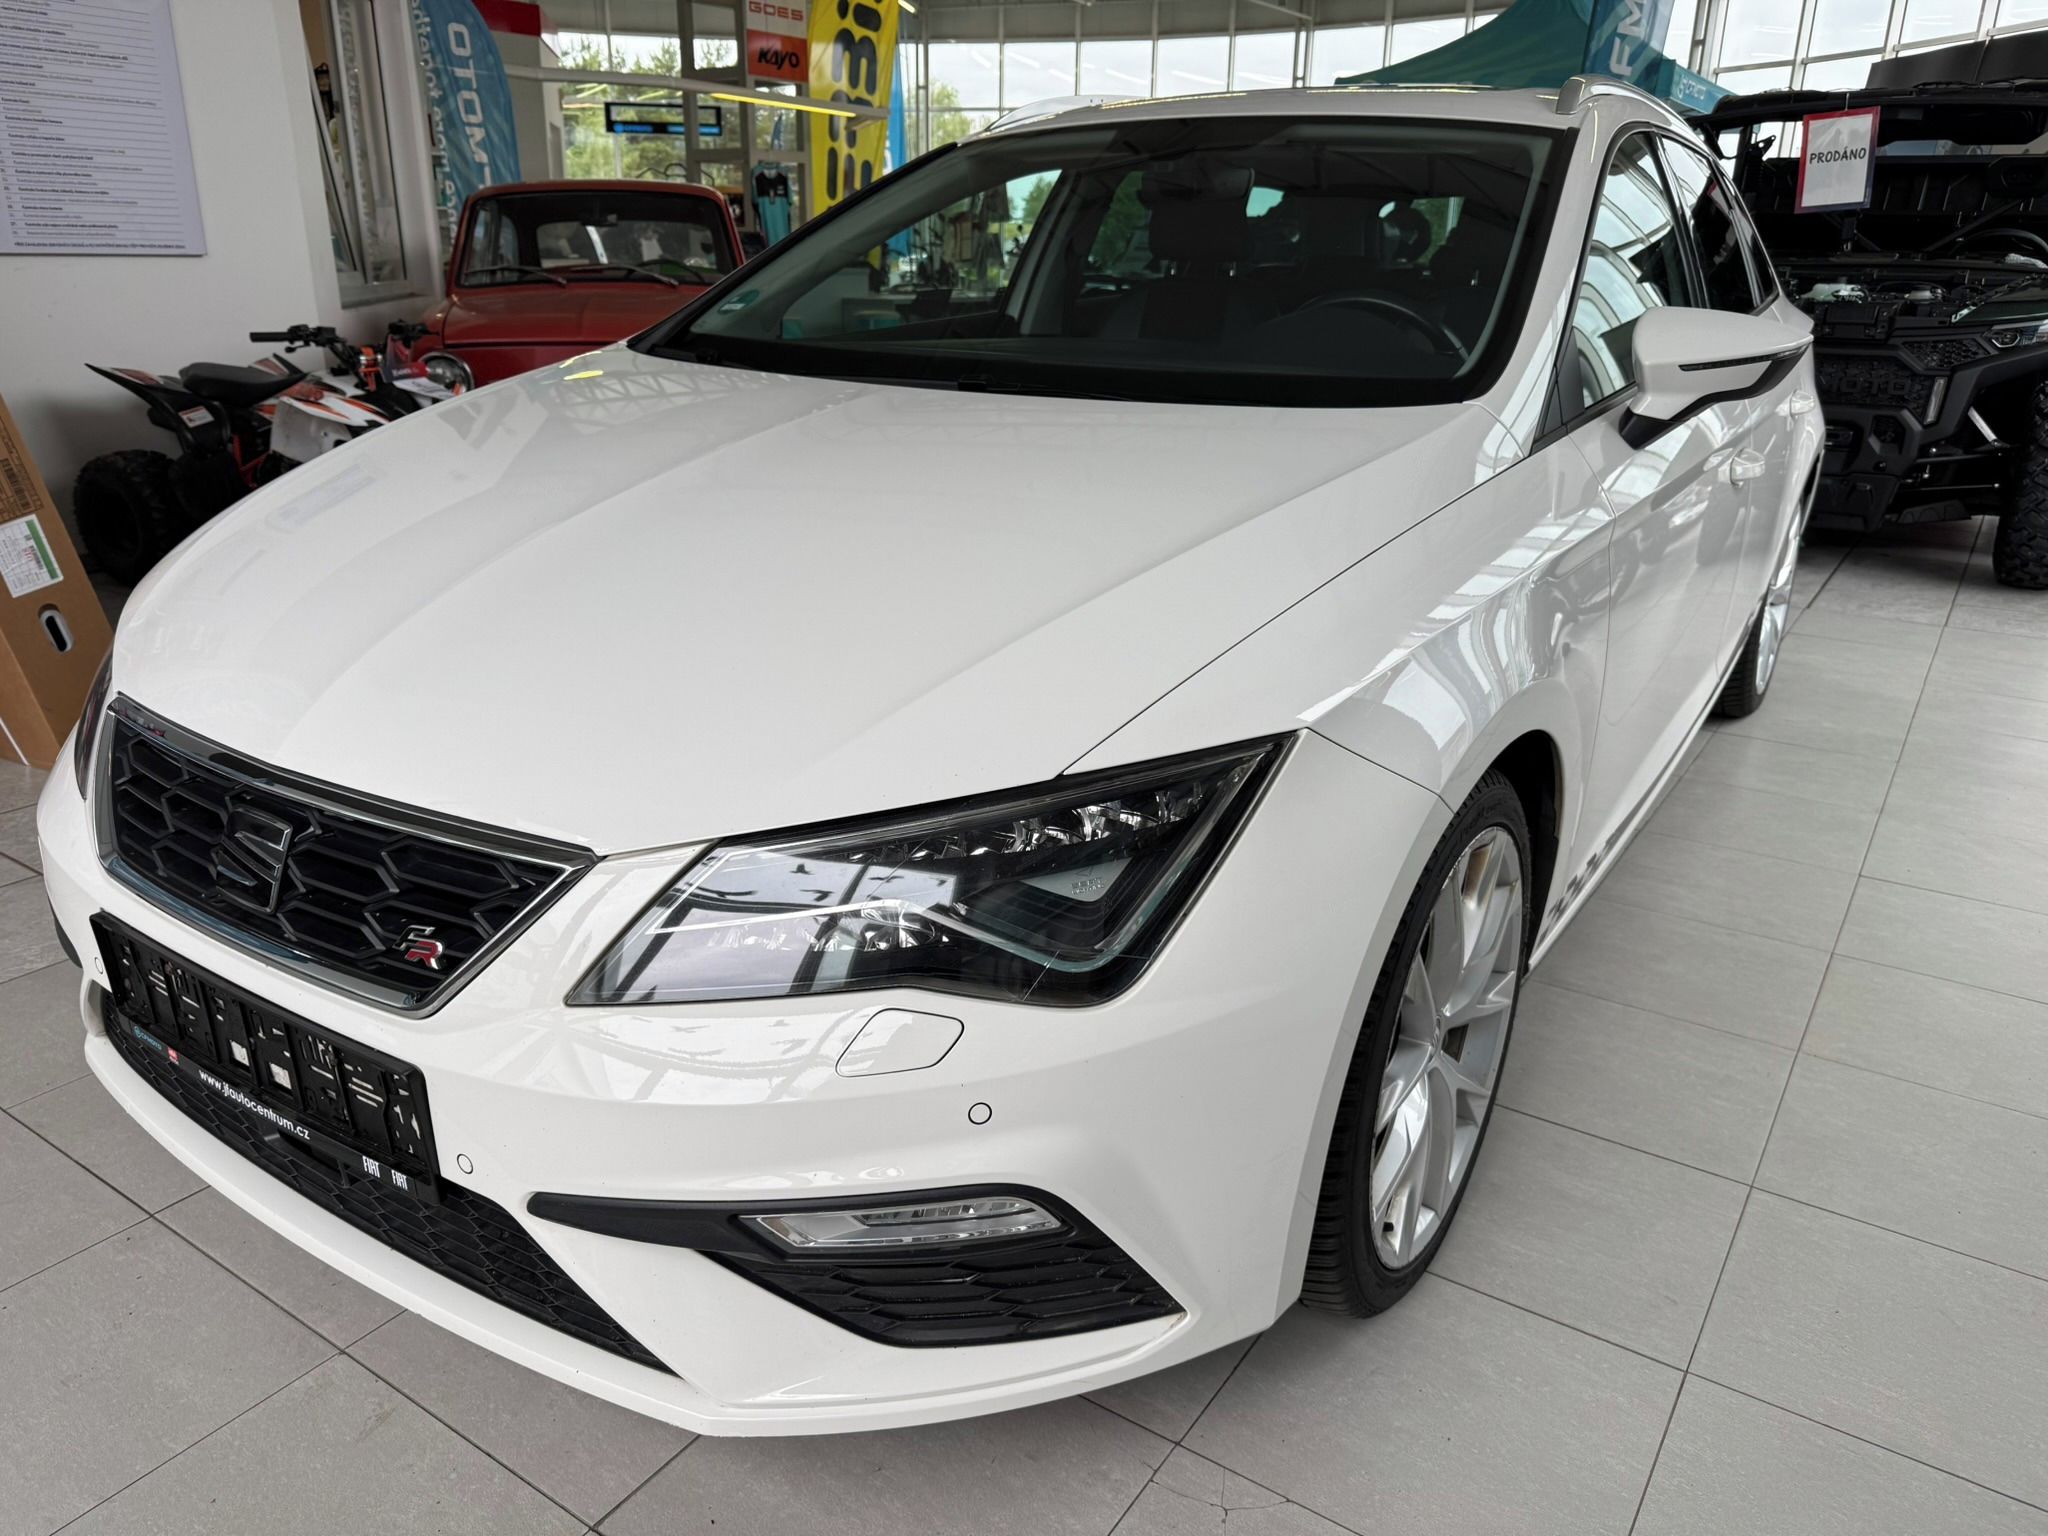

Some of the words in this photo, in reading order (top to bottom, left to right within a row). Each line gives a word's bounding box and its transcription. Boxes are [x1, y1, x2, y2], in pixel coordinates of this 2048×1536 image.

[748, 1, 804, 22] GOES
[757, 46, 800, 70] KAYO
[1809, 146, 1867, 164] PRODÁNO
[392, 924, 443, 970] FR
[198, 1069, 311, 1140] www.jfautocentrum.cz
[362, 1155, 382, 1179] FIAT
[391, 1169, 409, 1191] FIAT
